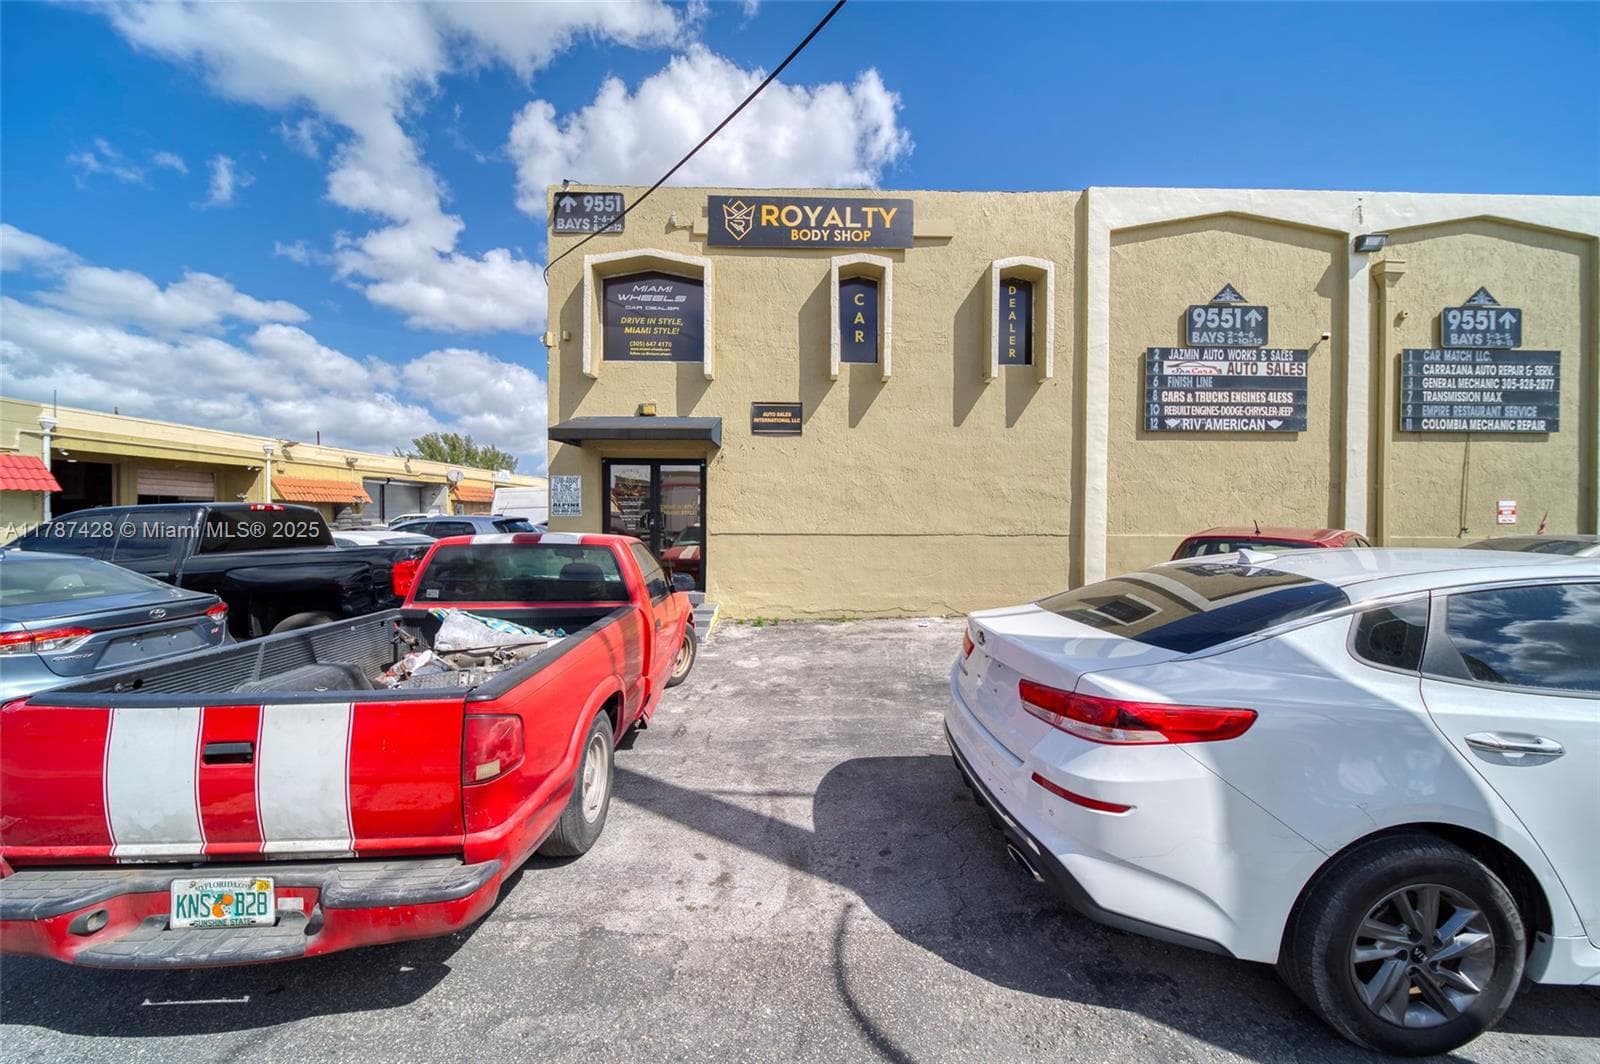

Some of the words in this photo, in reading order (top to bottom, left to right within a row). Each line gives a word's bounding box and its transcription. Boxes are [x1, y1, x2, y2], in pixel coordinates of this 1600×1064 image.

[584, 194, 620, 212] 9551
[761, 205, 898, 228] ROYALTY
[557, 218, 590, 230] BAYS
[791, 230, 830, 241] BODY
[834, 230, 871, 242] SHOP
[618, 294, 686, 302] WHEELS
[658, 318, 684, 326] STYLE,
[854, 294, 864, 343] CAR
[1008, 286, 1017, 358] DEALER
[1192, 308, 1242, 328] 9551
[1448, 310, 1496, 330] 9551
[1192, 332, 1225, 343] BAYS
[1450, 334, 1483, 344] BAYS
[1154, 349, 1160, 360] 2
[1168, 349, 1199, 360] JAZMIN
[1202, 349, 1224, 360] AUTO
[1228, 350, 1257, 361] WORKS
[1270, 351, 1293, 361] SALES
[1423, 351, 1440, 361] CAR
[1444, 351, 1472, 361] MATCH
[1476, 351, 1492, 361] LLC.
[1153, 363, 1160, 373] 4
[1227, 363, 1258, 374] AUTO
[1266, 363, 1304, 375] SALES
[1422, 364, 1473, 375] CARRAZANA
[1475, 364, 1496, 375] AUTO
[1498, 365, 1524, 376] REPAIR
[1525, 366, 1533, 376] &
[1534, 365, 1555, 376] SERV.
[1153, 376, 1159, 387] 6
[1167, 376, 1192, 387] FINISH
[1196, 377, 1213, 387] LINE
[1422, 378, 1456, 389] GENERAL
[1458, 378, 1500, 389] MECHANIC
[1152, 390, 1158, 401] 8
[1162, 391, 1184, 402] CARS
[1186, 392, 1192, 402] &
[1195, 392, 1229, 402] TRUCKS
[1231, 392, 1266, 403] ENGINES
[1268, 392, 1293, 403] 4LESS
[1422, 391, 1480, 402] TRANSMISSION
[1482, 392, 1502, 402] MAX
[1150, 404, 1160, 415] 10
[1164, 406, 1190, 415] REBUILT
[1407, 406, 1412, 416] 9
[1422, 405, 1449, 416] EMPIRE
[1453, 406, 1500, 417] RESTAURANT
[1504, 406, 1537, 417] SERVICE
[1150, 418, 1158, 429] 12
[1205, 419, 1265, 430] AMERICAN
[1422, 418, 1468, 430] COLOMBIA
[1470, 419, 1515, 431] MECHANIC
[1517, 420, 1545, 431] REPAIR
[176, 893, 211, 919] KNS
